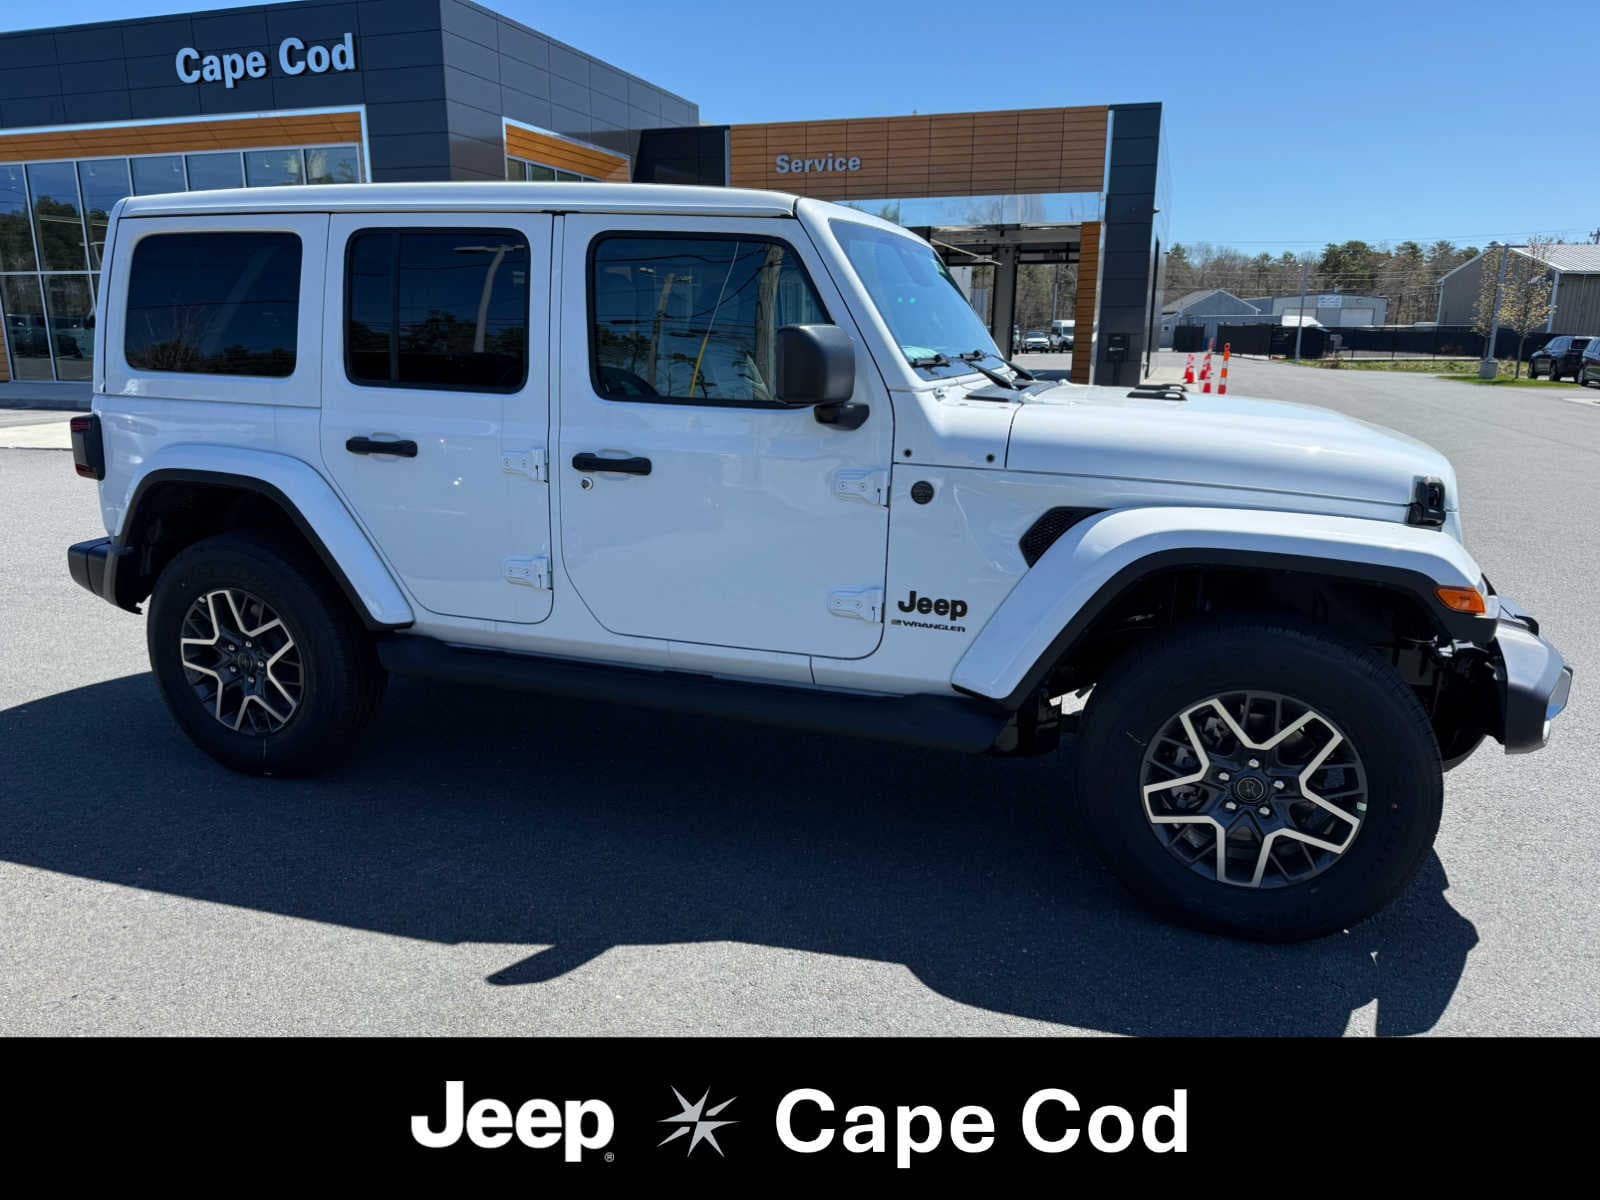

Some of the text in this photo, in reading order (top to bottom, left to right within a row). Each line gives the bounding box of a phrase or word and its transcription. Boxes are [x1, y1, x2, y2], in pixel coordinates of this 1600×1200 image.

[176, 32, 355, 89] Cape Cod
[775, 153, 861, 174] Service
[897, 590, 968, 621] Jeep
[902, 619, 966, 632] WRANGLER
